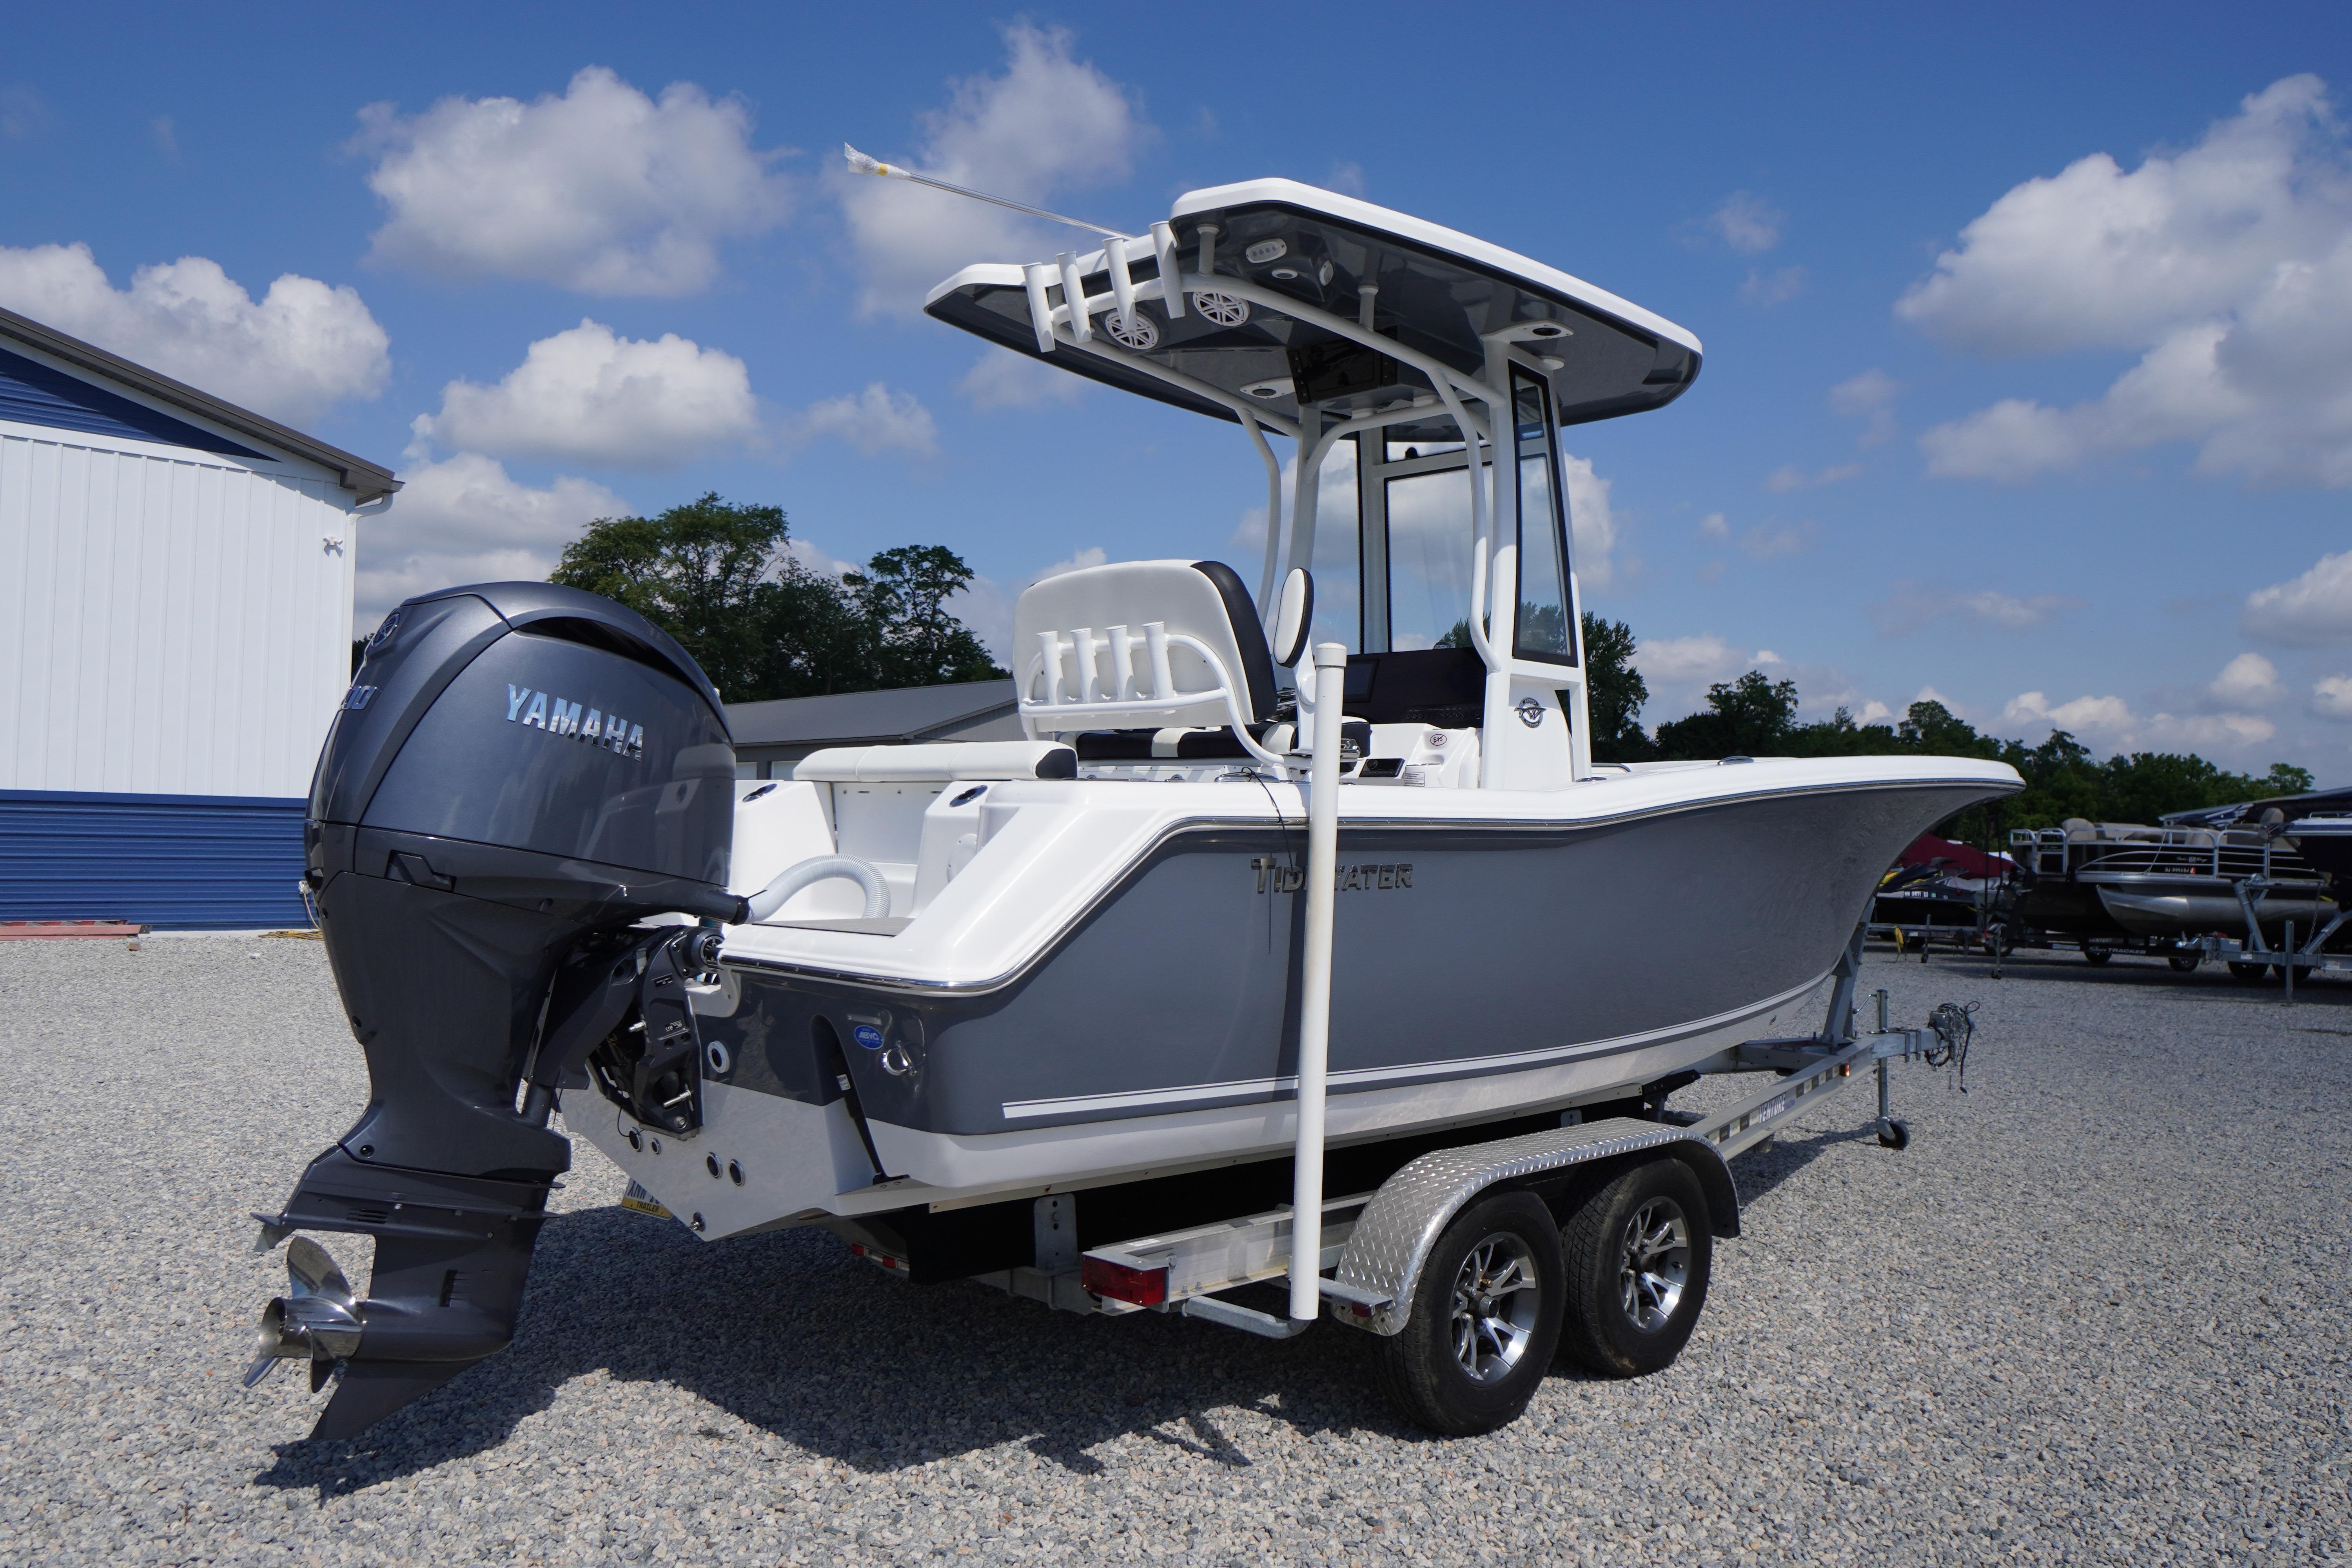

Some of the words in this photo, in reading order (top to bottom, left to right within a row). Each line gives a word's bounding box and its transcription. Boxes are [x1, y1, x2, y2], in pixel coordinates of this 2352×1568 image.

[340, 685, 378, 710] 00
[507, 683, 644, 761] YAMAHA
[1250, 856, 1413, 893] TIDATER
[1759, 1094, 1786, 1124] VENTURE
[636, 1201, 659, 1213] TRAILER
